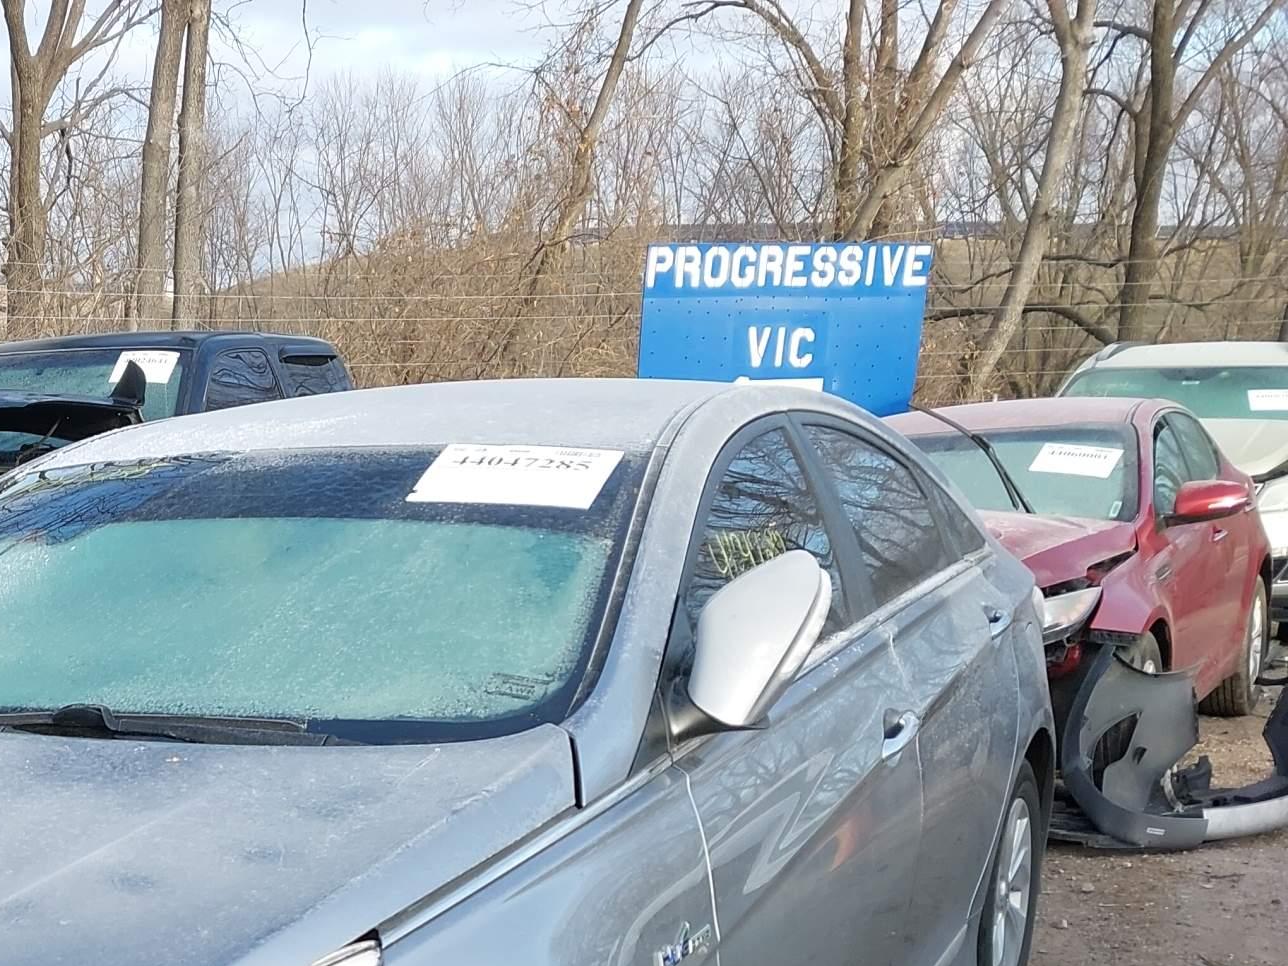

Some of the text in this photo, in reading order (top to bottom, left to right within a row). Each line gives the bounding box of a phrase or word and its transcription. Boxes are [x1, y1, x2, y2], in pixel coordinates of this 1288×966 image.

[646, 245, 933, 289] PROGRESSIVE
[747, 325, 815, 369] VIC
[452, 455, 593, 471] 44047285
